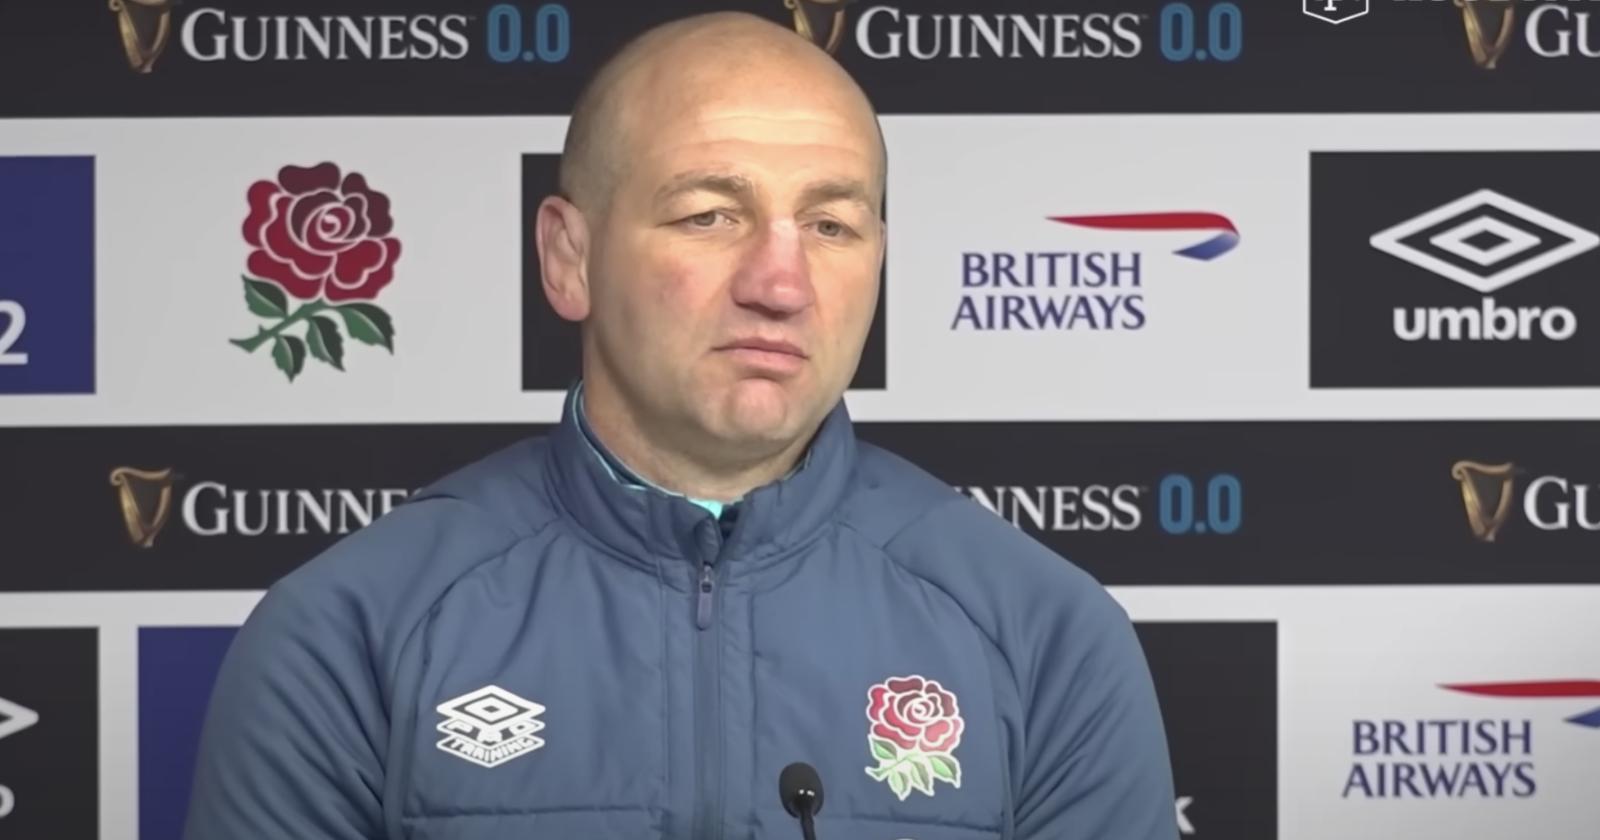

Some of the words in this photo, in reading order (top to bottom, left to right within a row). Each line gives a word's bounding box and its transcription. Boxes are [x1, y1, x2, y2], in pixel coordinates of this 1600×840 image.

[181, 8, 470, 62] GUINNESS
[486, 4, 570, 62] 0.0
[855, 6, 1143, 60] GUINNESS
[1160, 2, 1243, 62] 0.0
[961, 252, 1142, 288] BRITISH
[950, 295, 1146, 331] AIRWAYS
[1393, 297, 1577, 341] umbro
[182, 481, 422, 535] GUINN
[953, 484, 1142, 531] NNESS
[1159, 474, 1242, 534] 0.0
[450, 738, 535, 762] TRAINING
[1352, 720, 1533, 756] BRITISH
[1342, 762, 1536, 799] AIRWAYS
